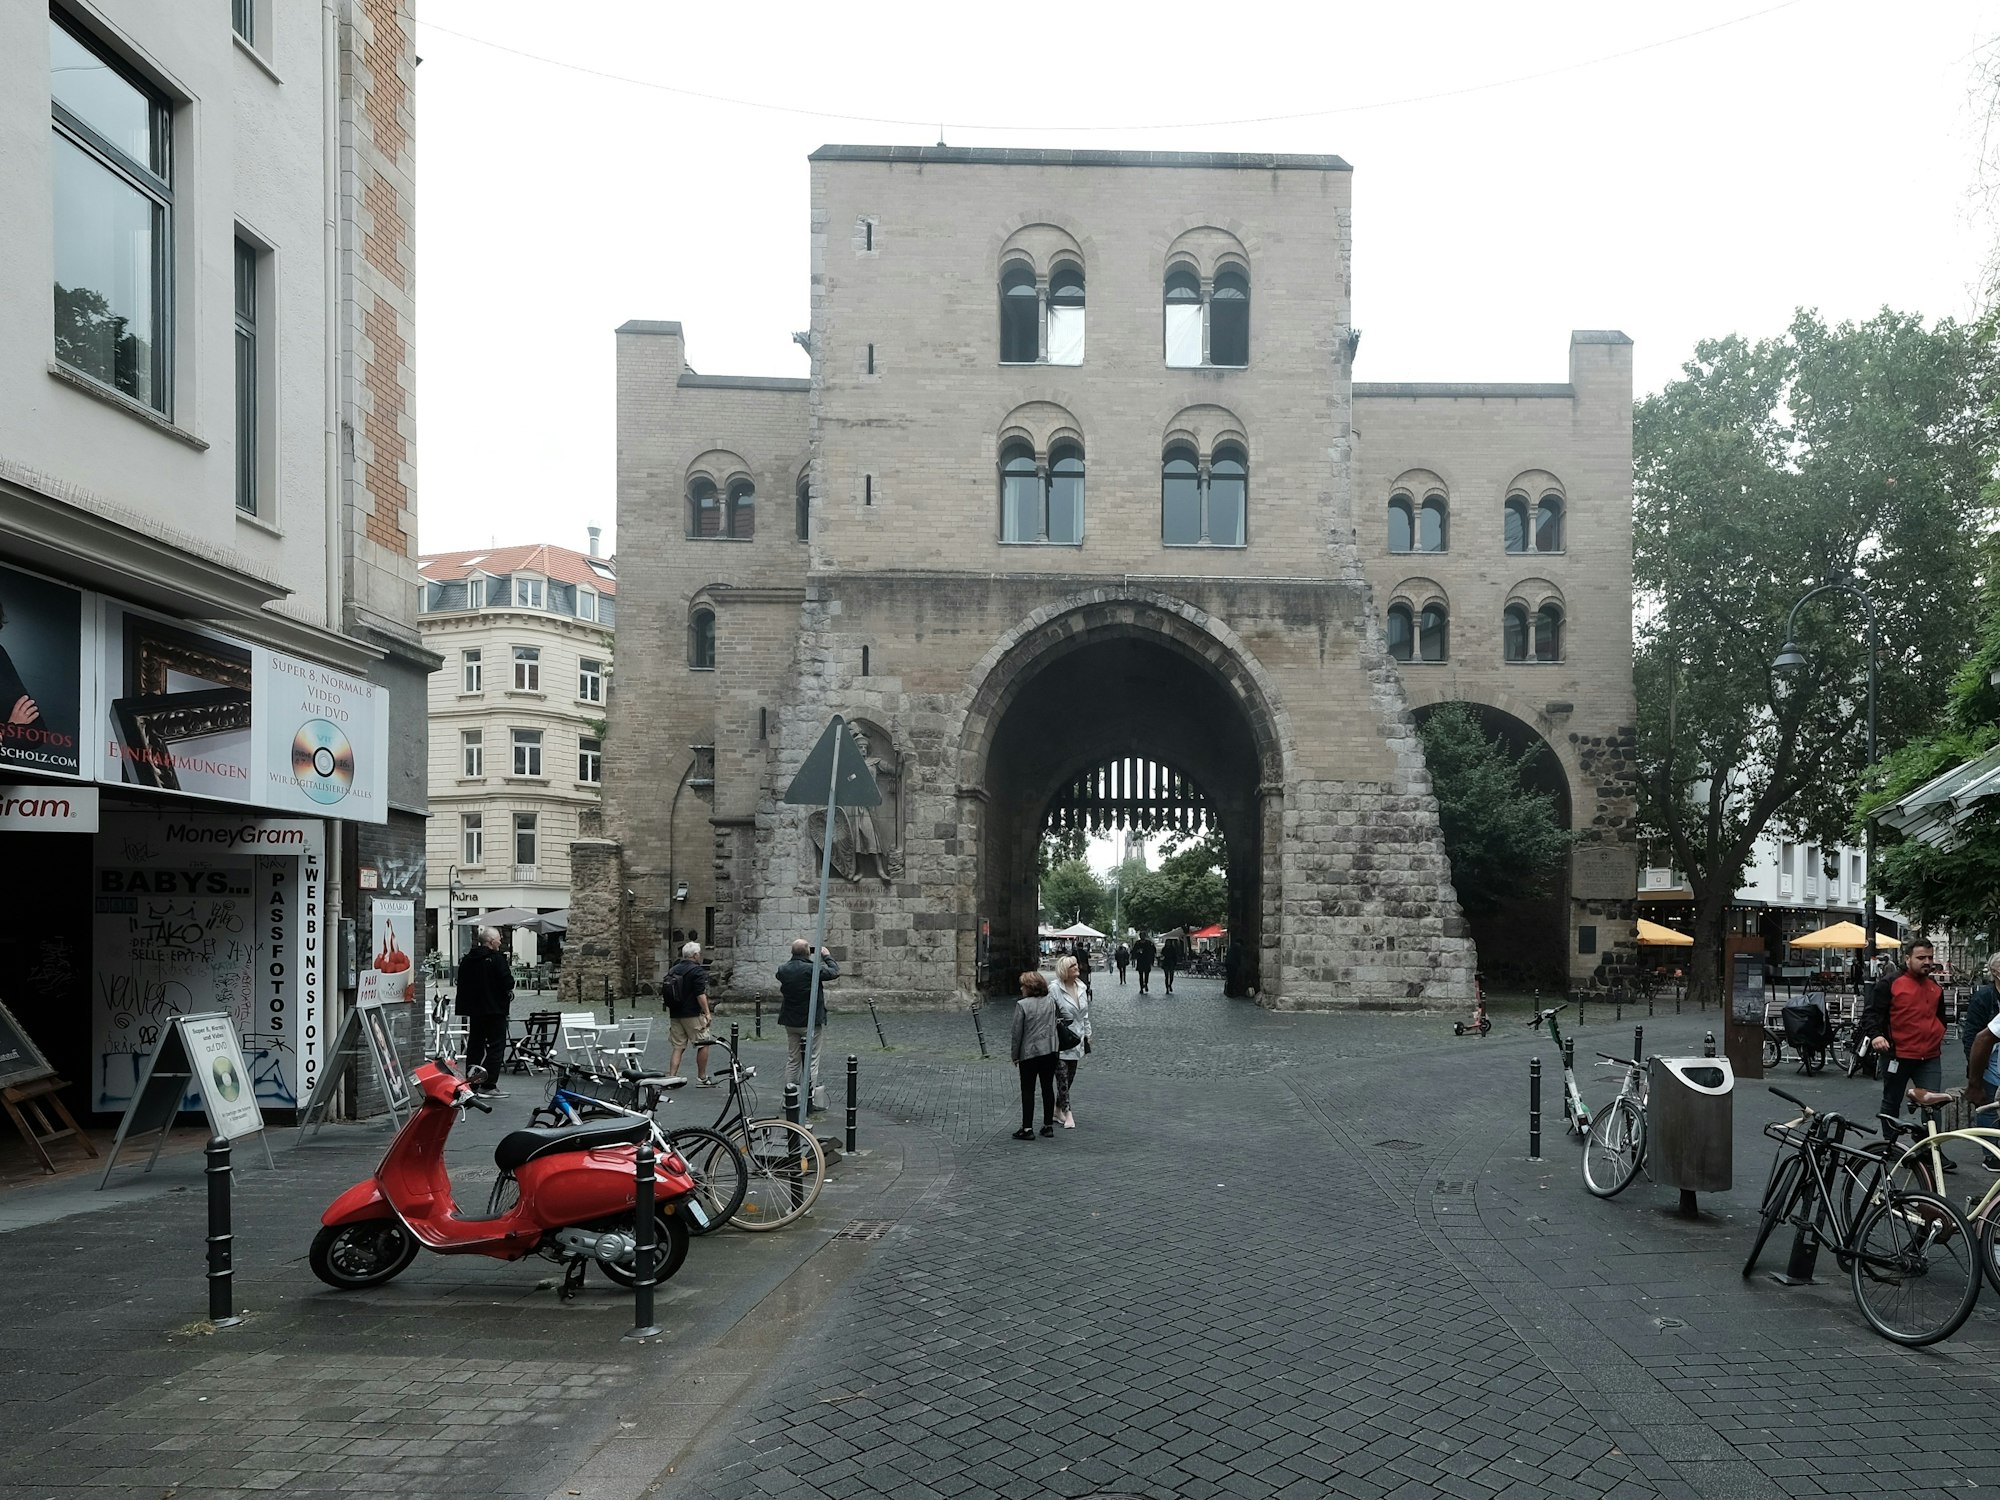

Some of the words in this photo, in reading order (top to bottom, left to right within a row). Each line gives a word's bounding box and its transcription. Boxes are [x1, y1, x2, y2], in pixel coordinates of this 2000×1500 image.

[272, 658, 306, 678] SUPER
[321, 673, 364, 696] NORMAL
[366, 687, 372, 698] 8
[307, 685, 341, 704] VIDEO
[301, 701, 321, 714] AUF
[325, 706, 349, 722] DVD
[108, 740, 247, 779] EINRAHMUNGEN
[269, 772, 288, 784] WIR
[290, 777, 351, 794] DIGITALISIEREN
[353, 789, 372, 799] ALLES
[0, 795, 70, 817] ram
[166, 824, 304, 848] MoneyGram
[380, 902, 408, 911] YOMARO
[269, 873, 285, 1031] PASSFOTOS
[365, 975, 378, 987] PASS
[361, 989, 377, 1001] FOTOS
[215, 1041, 227, 1051] DVD
